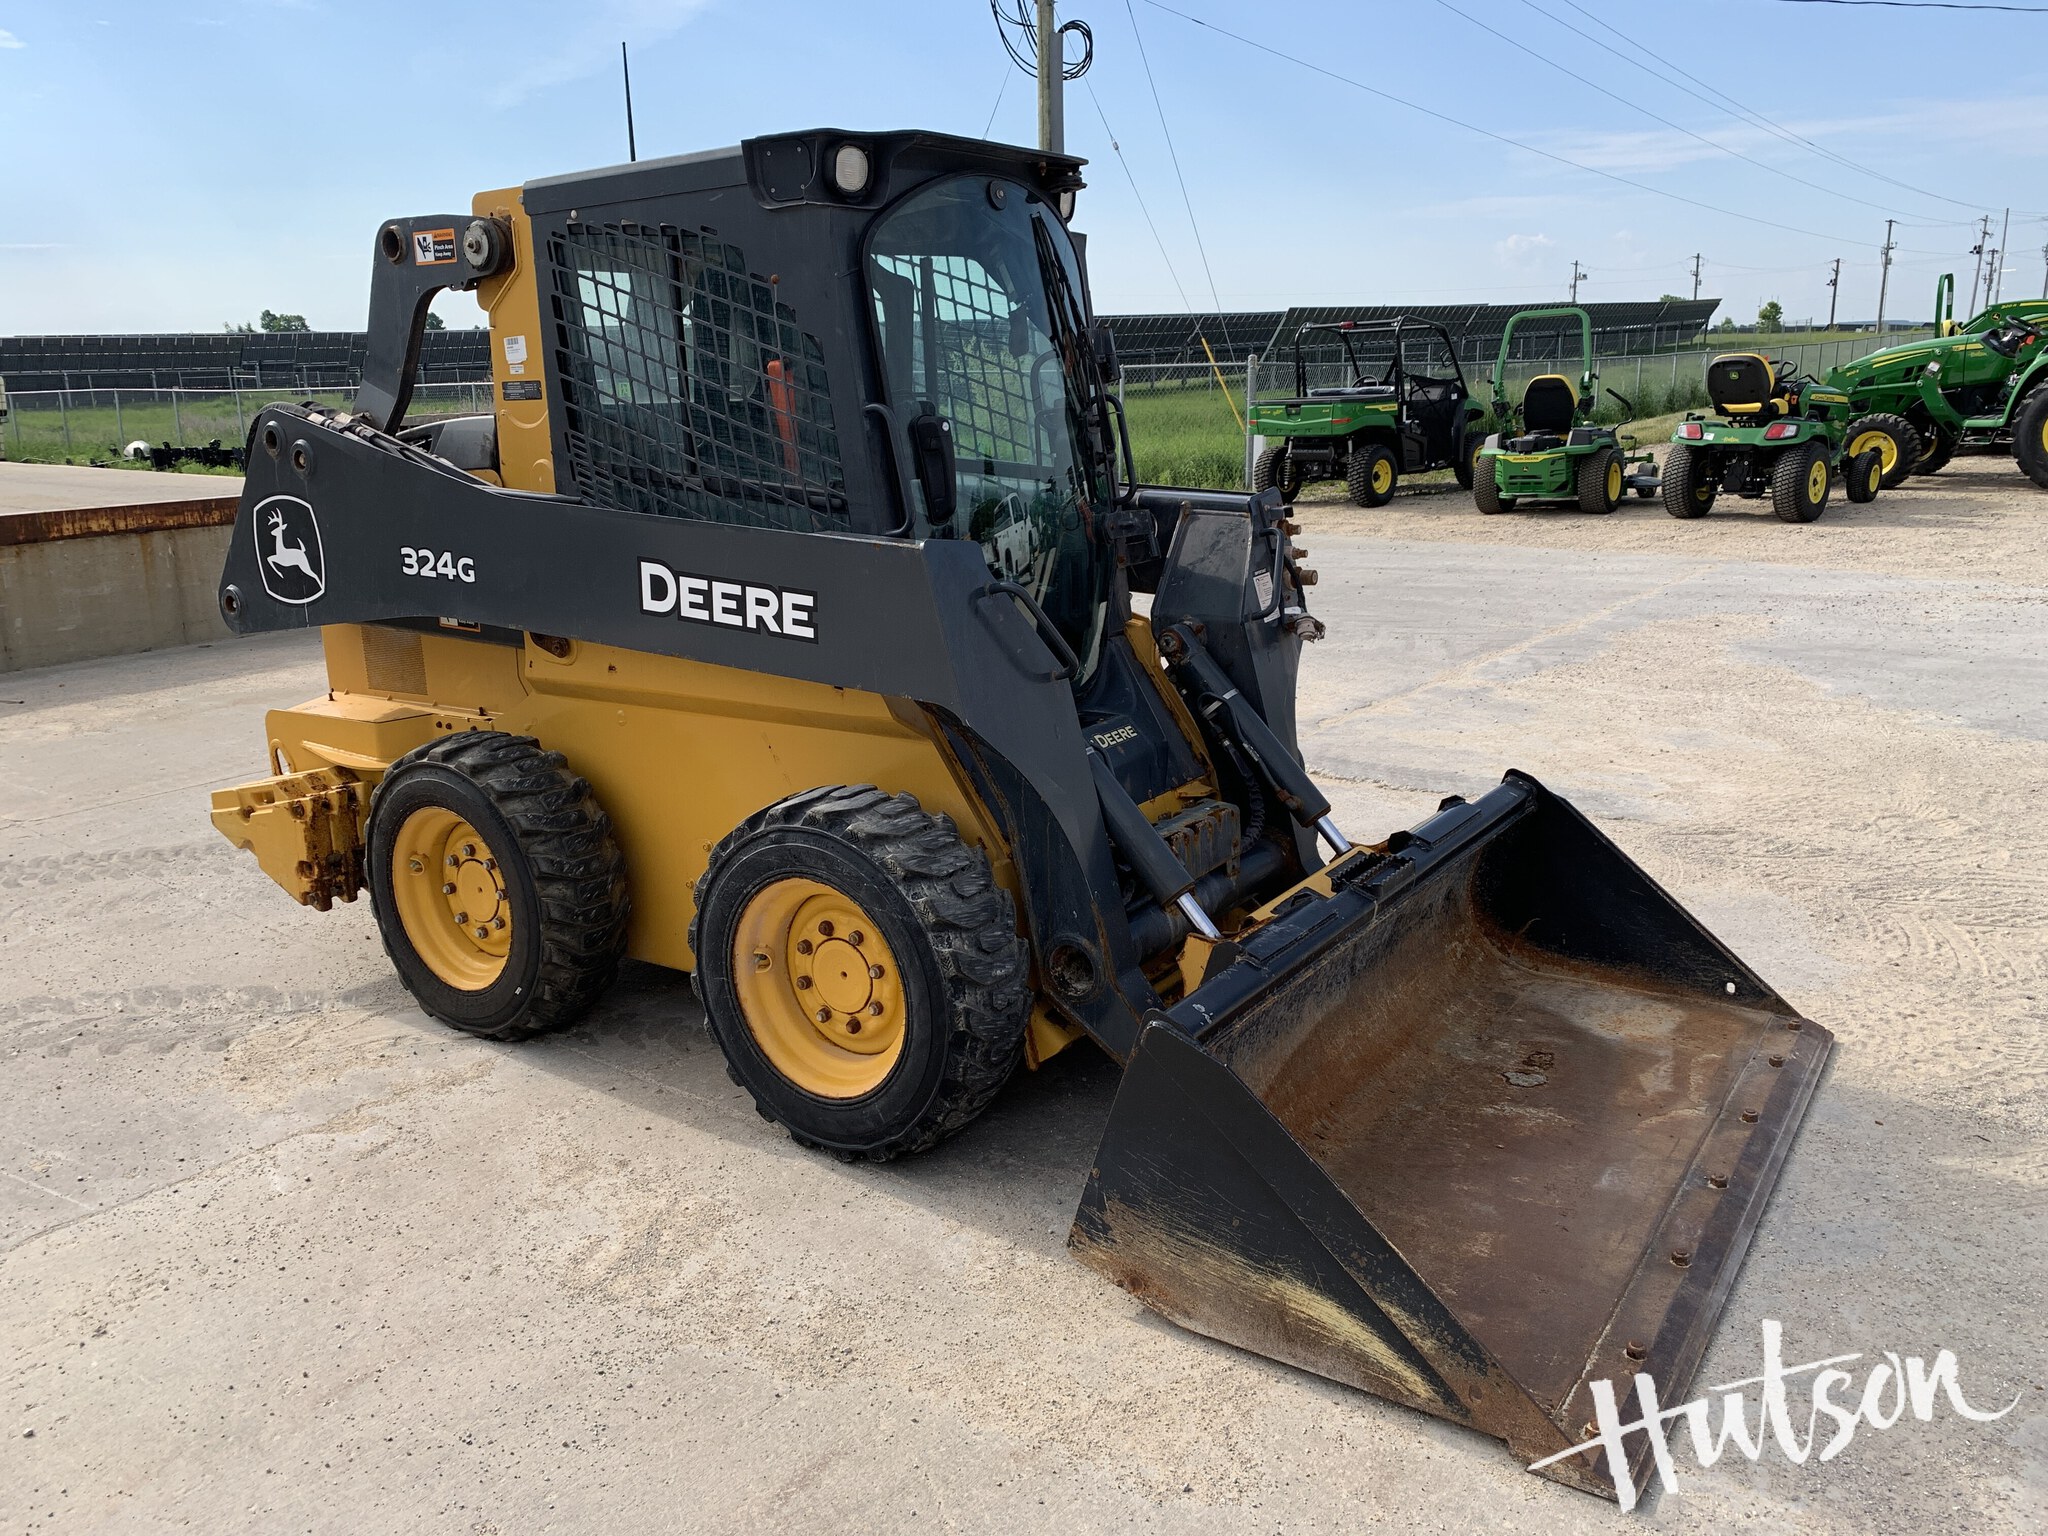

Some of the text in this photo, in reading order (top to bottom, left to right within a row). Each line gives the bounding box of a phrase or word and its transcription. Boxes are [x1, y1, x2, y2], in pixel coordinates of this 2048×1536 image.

[400, 546, 476, 583] 324G
[640, 561, 815, 639] DEERE
[1093, 725, 1138, 749] DEERE
